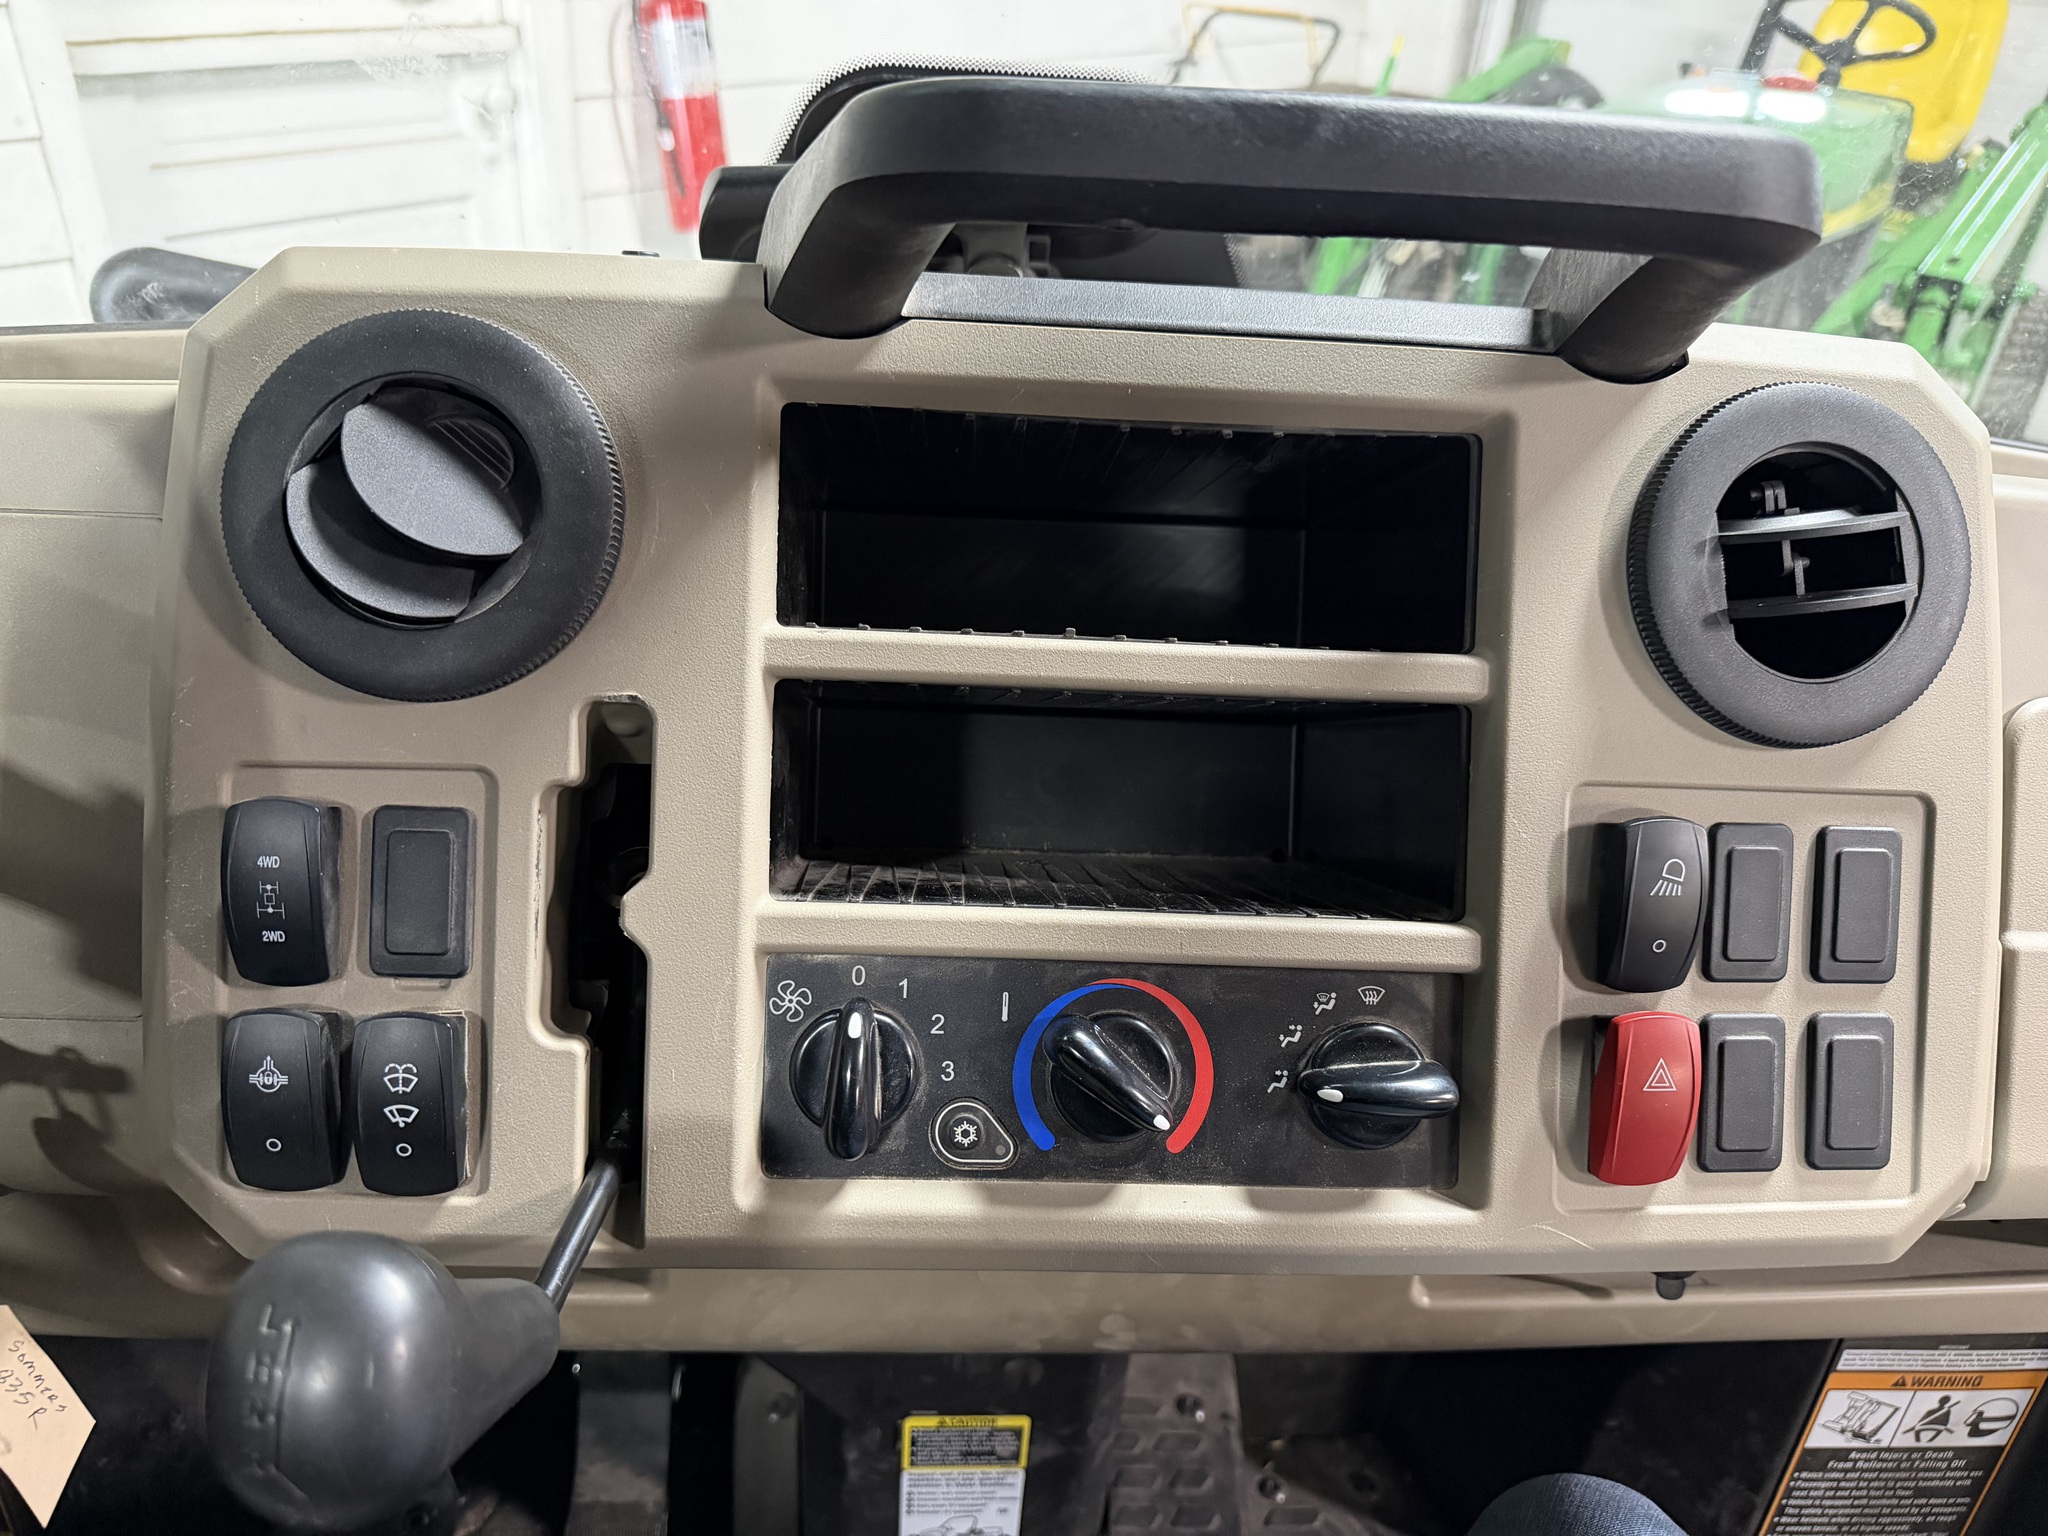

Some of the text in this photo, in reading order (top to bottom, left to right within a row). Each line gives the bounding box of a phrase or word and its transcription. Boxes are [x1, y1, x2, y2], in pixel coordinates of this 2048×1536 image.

[257, 856, 280, 868] 4WD
[262, 930, 286, 942] 2WD
[852, 965, 866, 986] 0
[898, 978, 908, 998] 1
[930, 1014, 945, 1035] 2
[941, 1061, 956, 1081] 3
[1910, 1375, 1984, 1388] WARNING
[1848, 1451, 1954, 1459] Avoid Injury or Death
[1827, 1460, 1968, 1469] From Rollover or Falling Off
